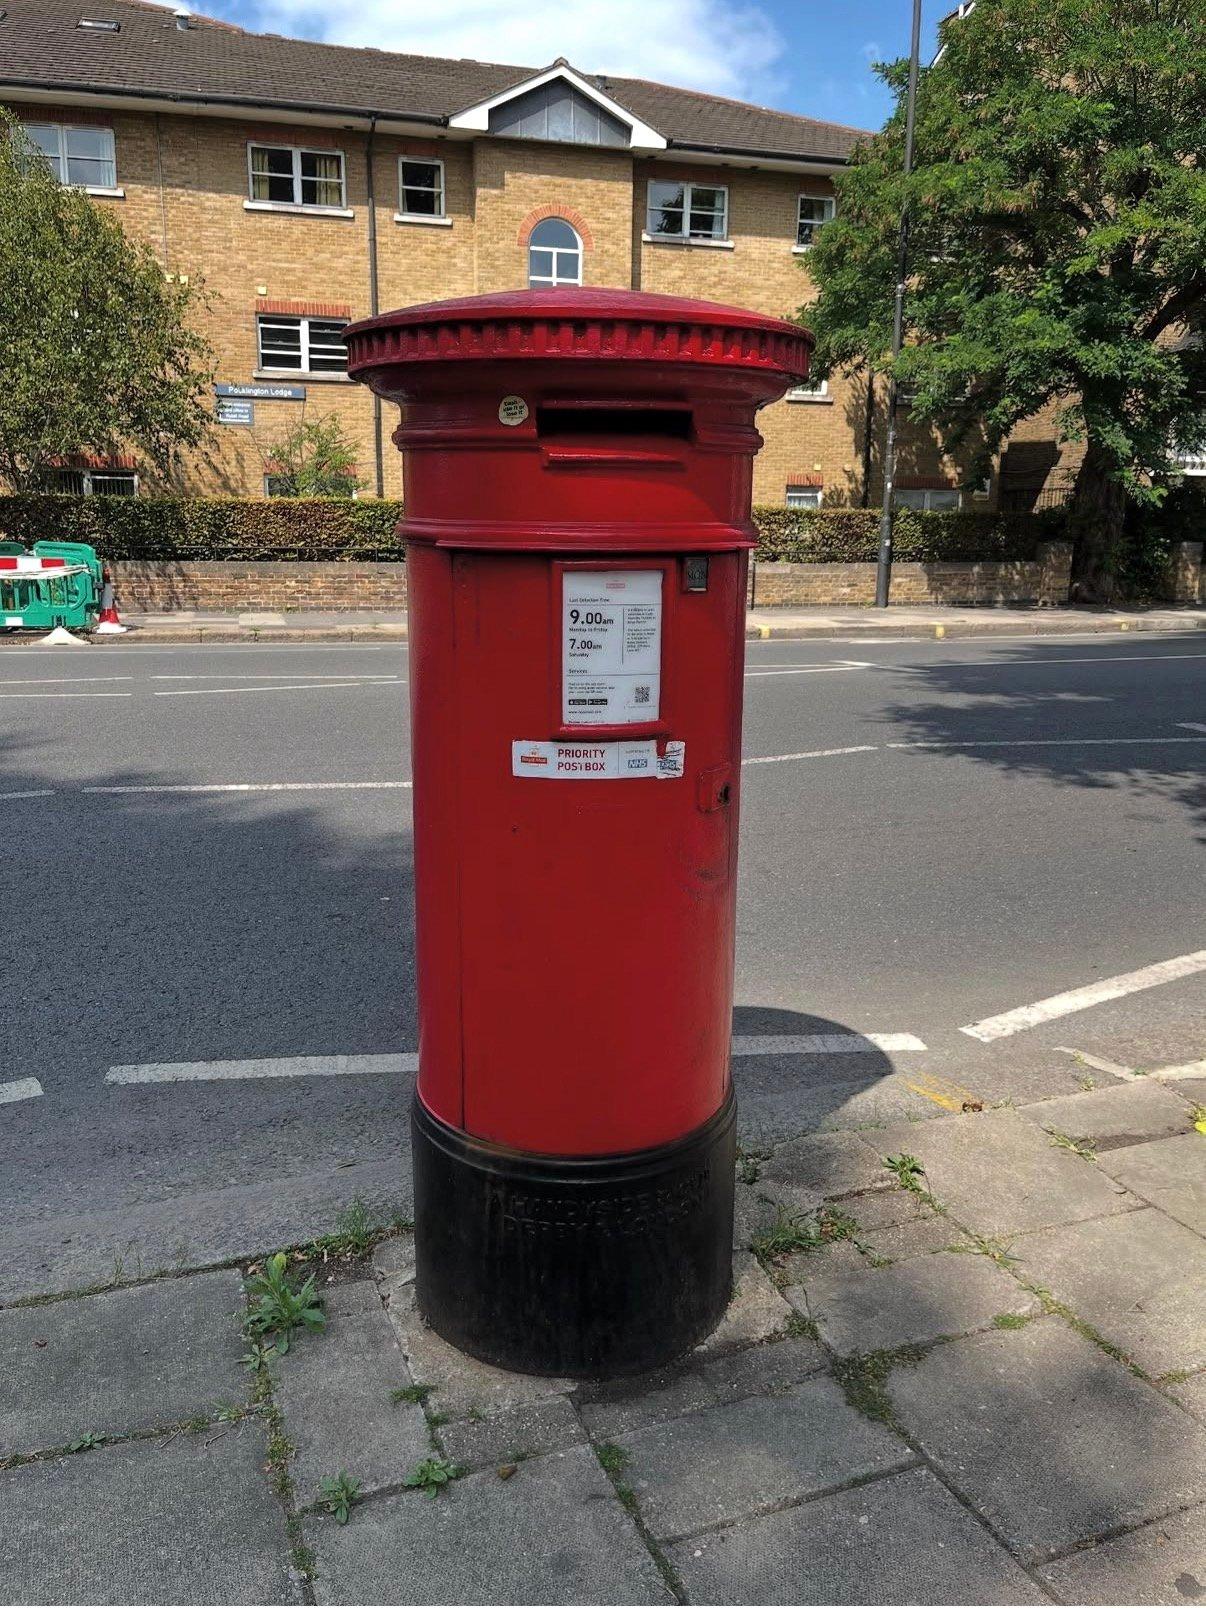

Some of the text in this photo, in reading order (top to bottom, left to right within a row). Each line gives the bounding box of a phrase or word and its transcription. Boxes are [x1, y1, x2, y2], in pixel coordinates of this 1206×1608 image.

[270, 389, 292, 397] Lodge
[570, 609, 614, 625] 9.00am
[569, 638, 602, 650] 7.00am
[558, 748, 605, 758] PRIORITY
[558, 762, 605, 771] POST BOX
[628, 759, 647, 768] NHS
